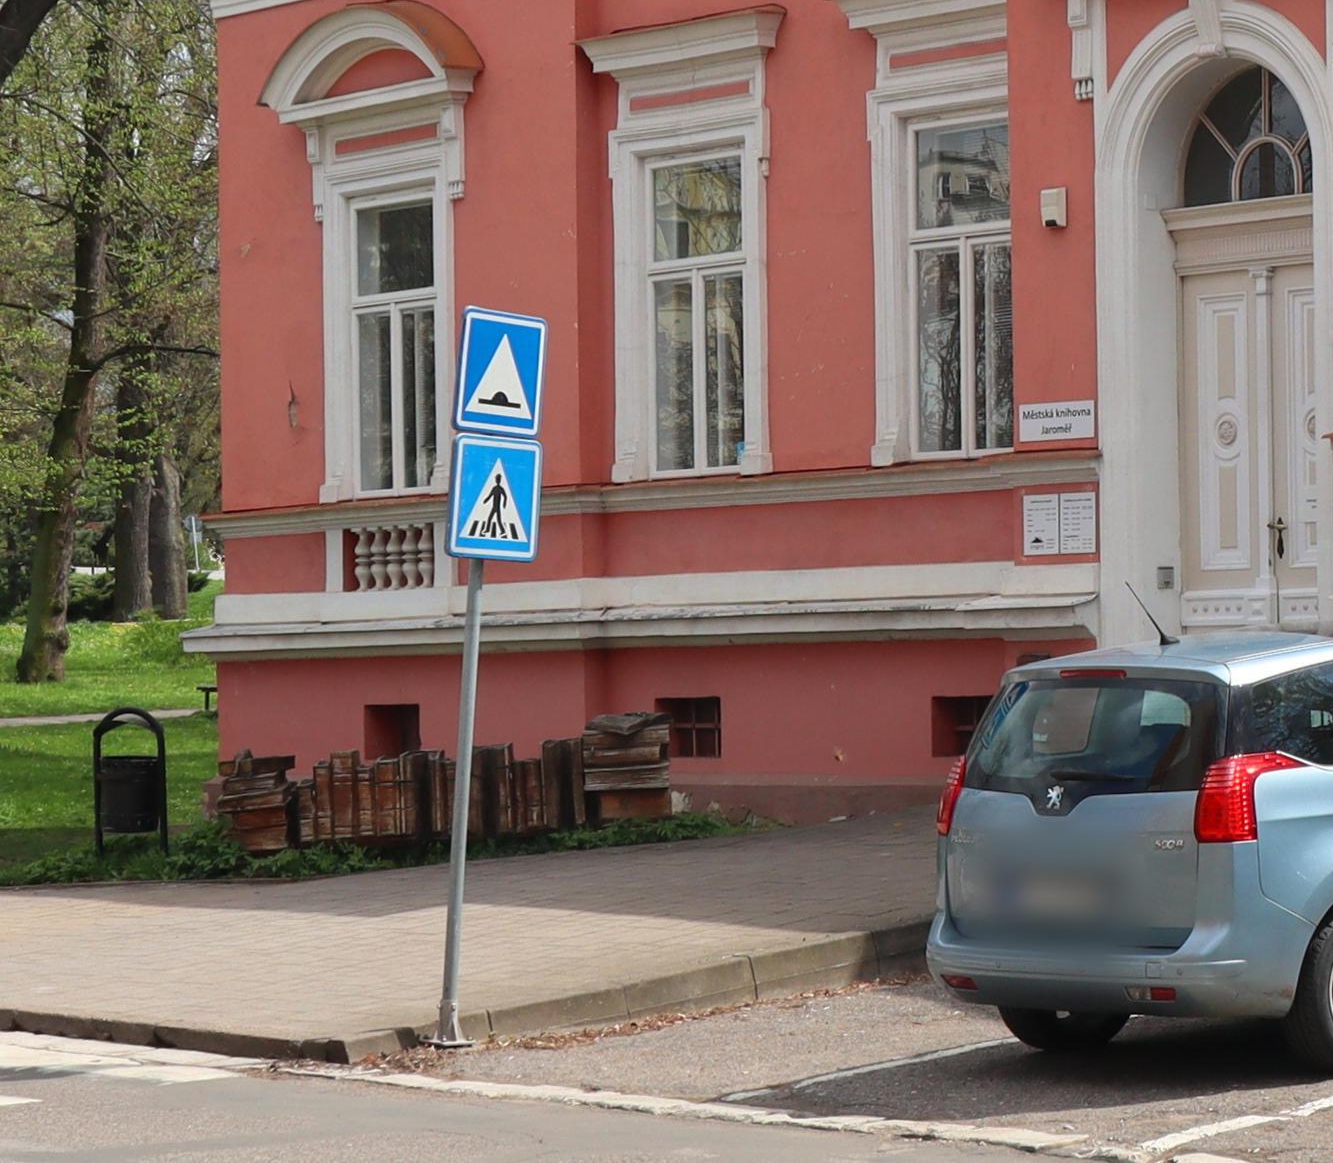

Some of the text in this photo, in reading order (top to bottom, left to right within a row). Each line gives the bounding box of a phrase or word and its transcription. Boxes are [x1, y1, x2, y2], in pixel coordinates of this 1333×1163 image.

[1022, 407, 1091, 420] Městská knihovna
[1041, 423, 1073, 435] Jaroměř
